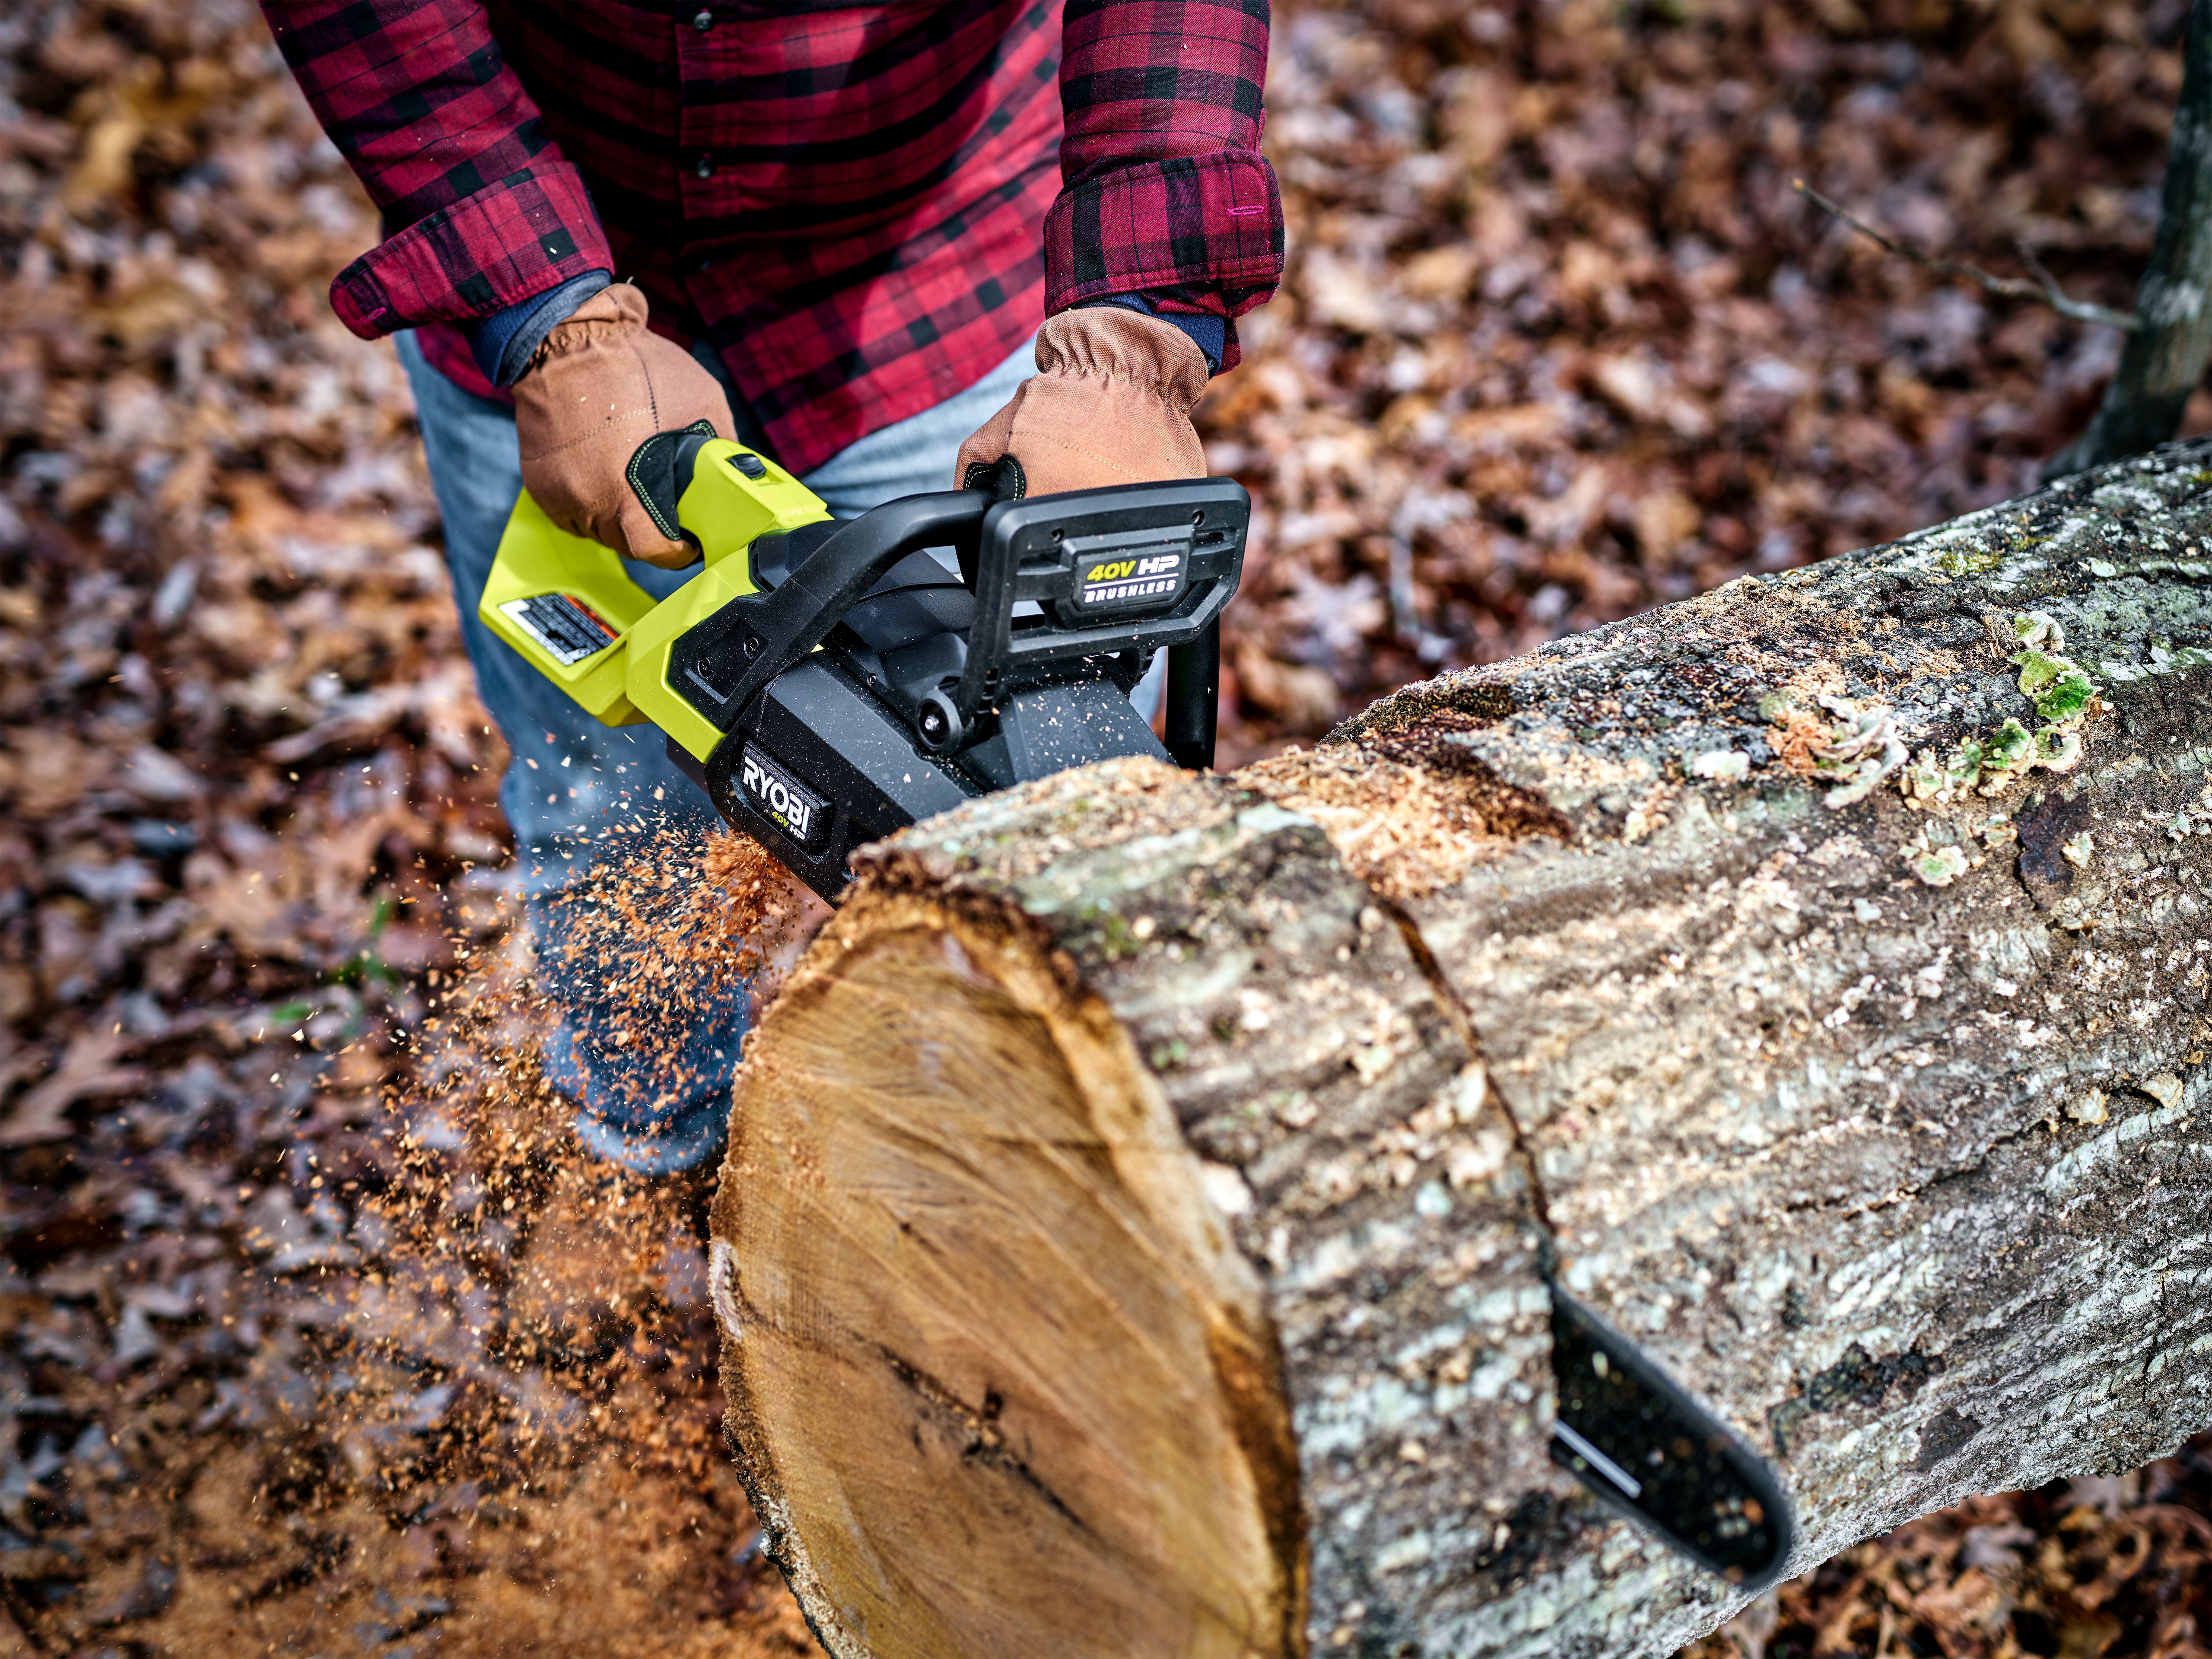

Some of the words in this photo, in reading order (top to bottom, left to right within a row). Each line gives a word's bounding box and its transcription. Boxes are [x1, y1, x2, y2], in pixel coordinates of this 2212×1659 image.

[1087, 560, 1136, 582] 40V
[1138, 555, 1180, 575] HP
[1084, 579, 1176, 603] BRUSHLESS
[743, 756, 810, 833] RYOBI
[772, 811, 790, 827] 40V
[789, 825, 805, 840] HP
